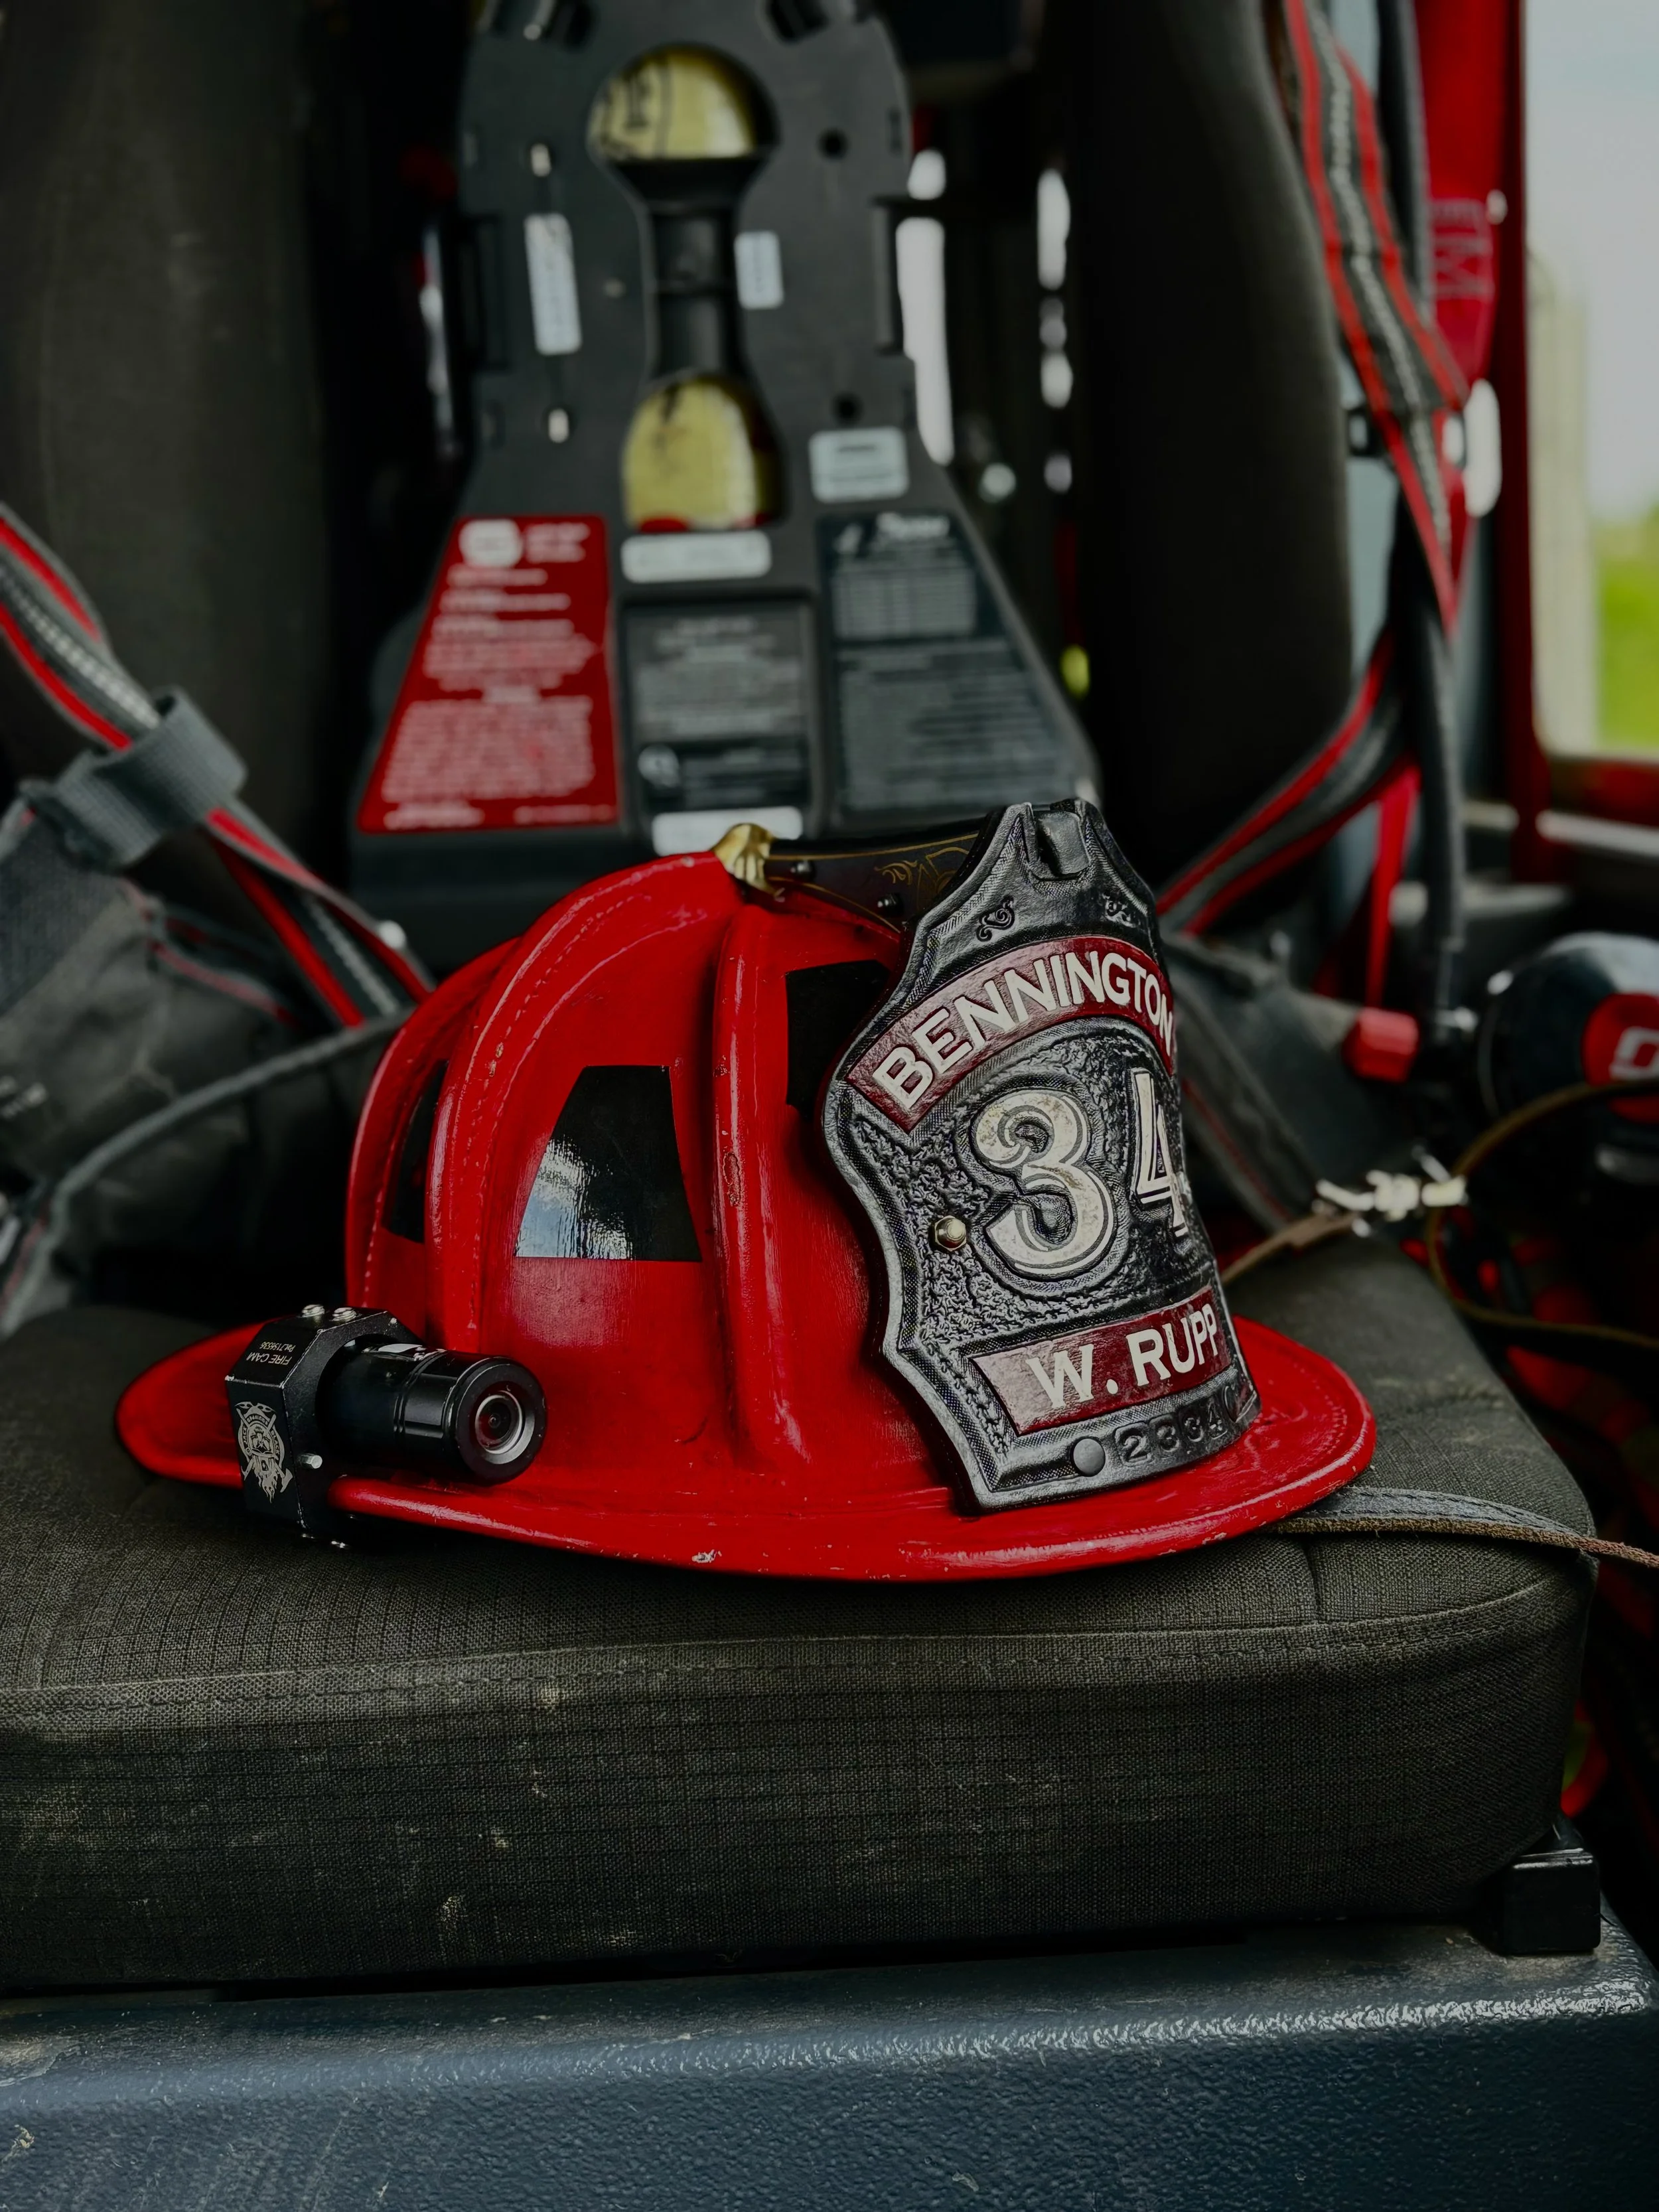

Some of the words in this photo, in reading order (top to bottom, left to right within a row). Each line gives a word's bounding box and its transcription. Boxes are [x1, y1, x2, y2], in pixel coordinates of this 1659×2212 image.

[872, 950, 1173, 1110] BENNINGTON
[975, 1067, 1189, 1276] 34
[246, 1351, 270, 1363] CAM
[267, 1354, 293, 1365] FIRE
[1025, 1343, 1119, 1408] W.
[1125, 1303, 1219, 1387] RUPP
